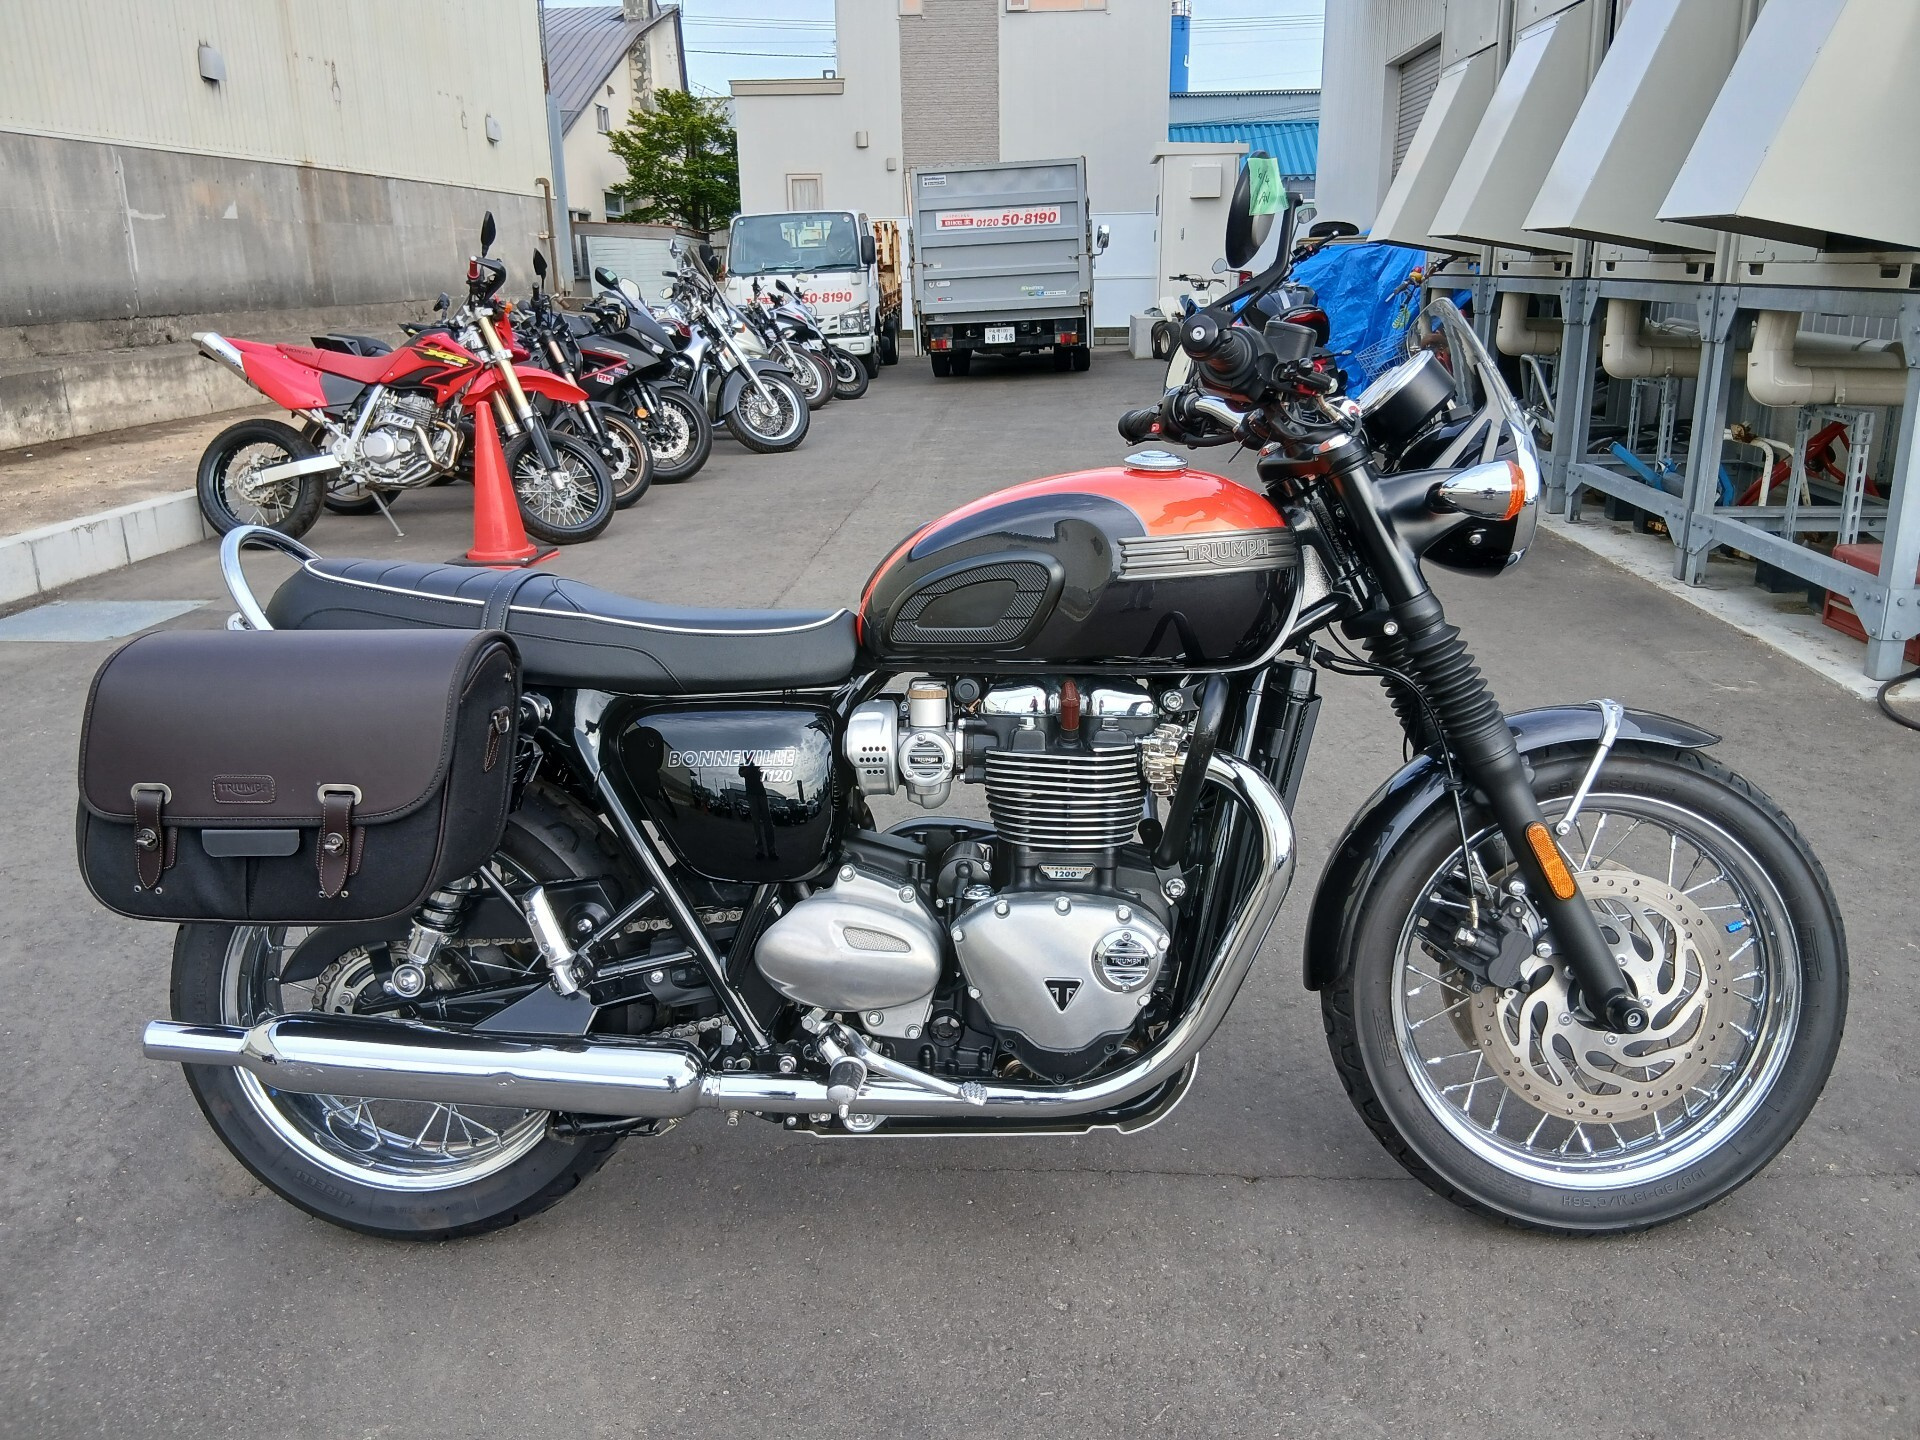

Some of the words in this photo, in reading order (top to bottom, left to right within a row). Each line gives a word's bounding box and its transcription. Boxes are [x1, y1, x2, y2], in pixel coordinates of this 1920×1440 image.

[976, 218, 999, 227] 0120
[1001, 211, 1057, 226] 50-8190
[802, 291, 852, 304] 50-8190
[285, 347, 313, 357] HONDA
[598, 374, 613, 383] RK
[1183, 539, 1269, 566] TRIUMPH
[668, 749, 797, 768] BONNEVILLE
[760, 768, 794, 782] T120
[218, 782, 270, 796] TRIUMPH
[1110, 957, 1142, 966] TRIUMPH
